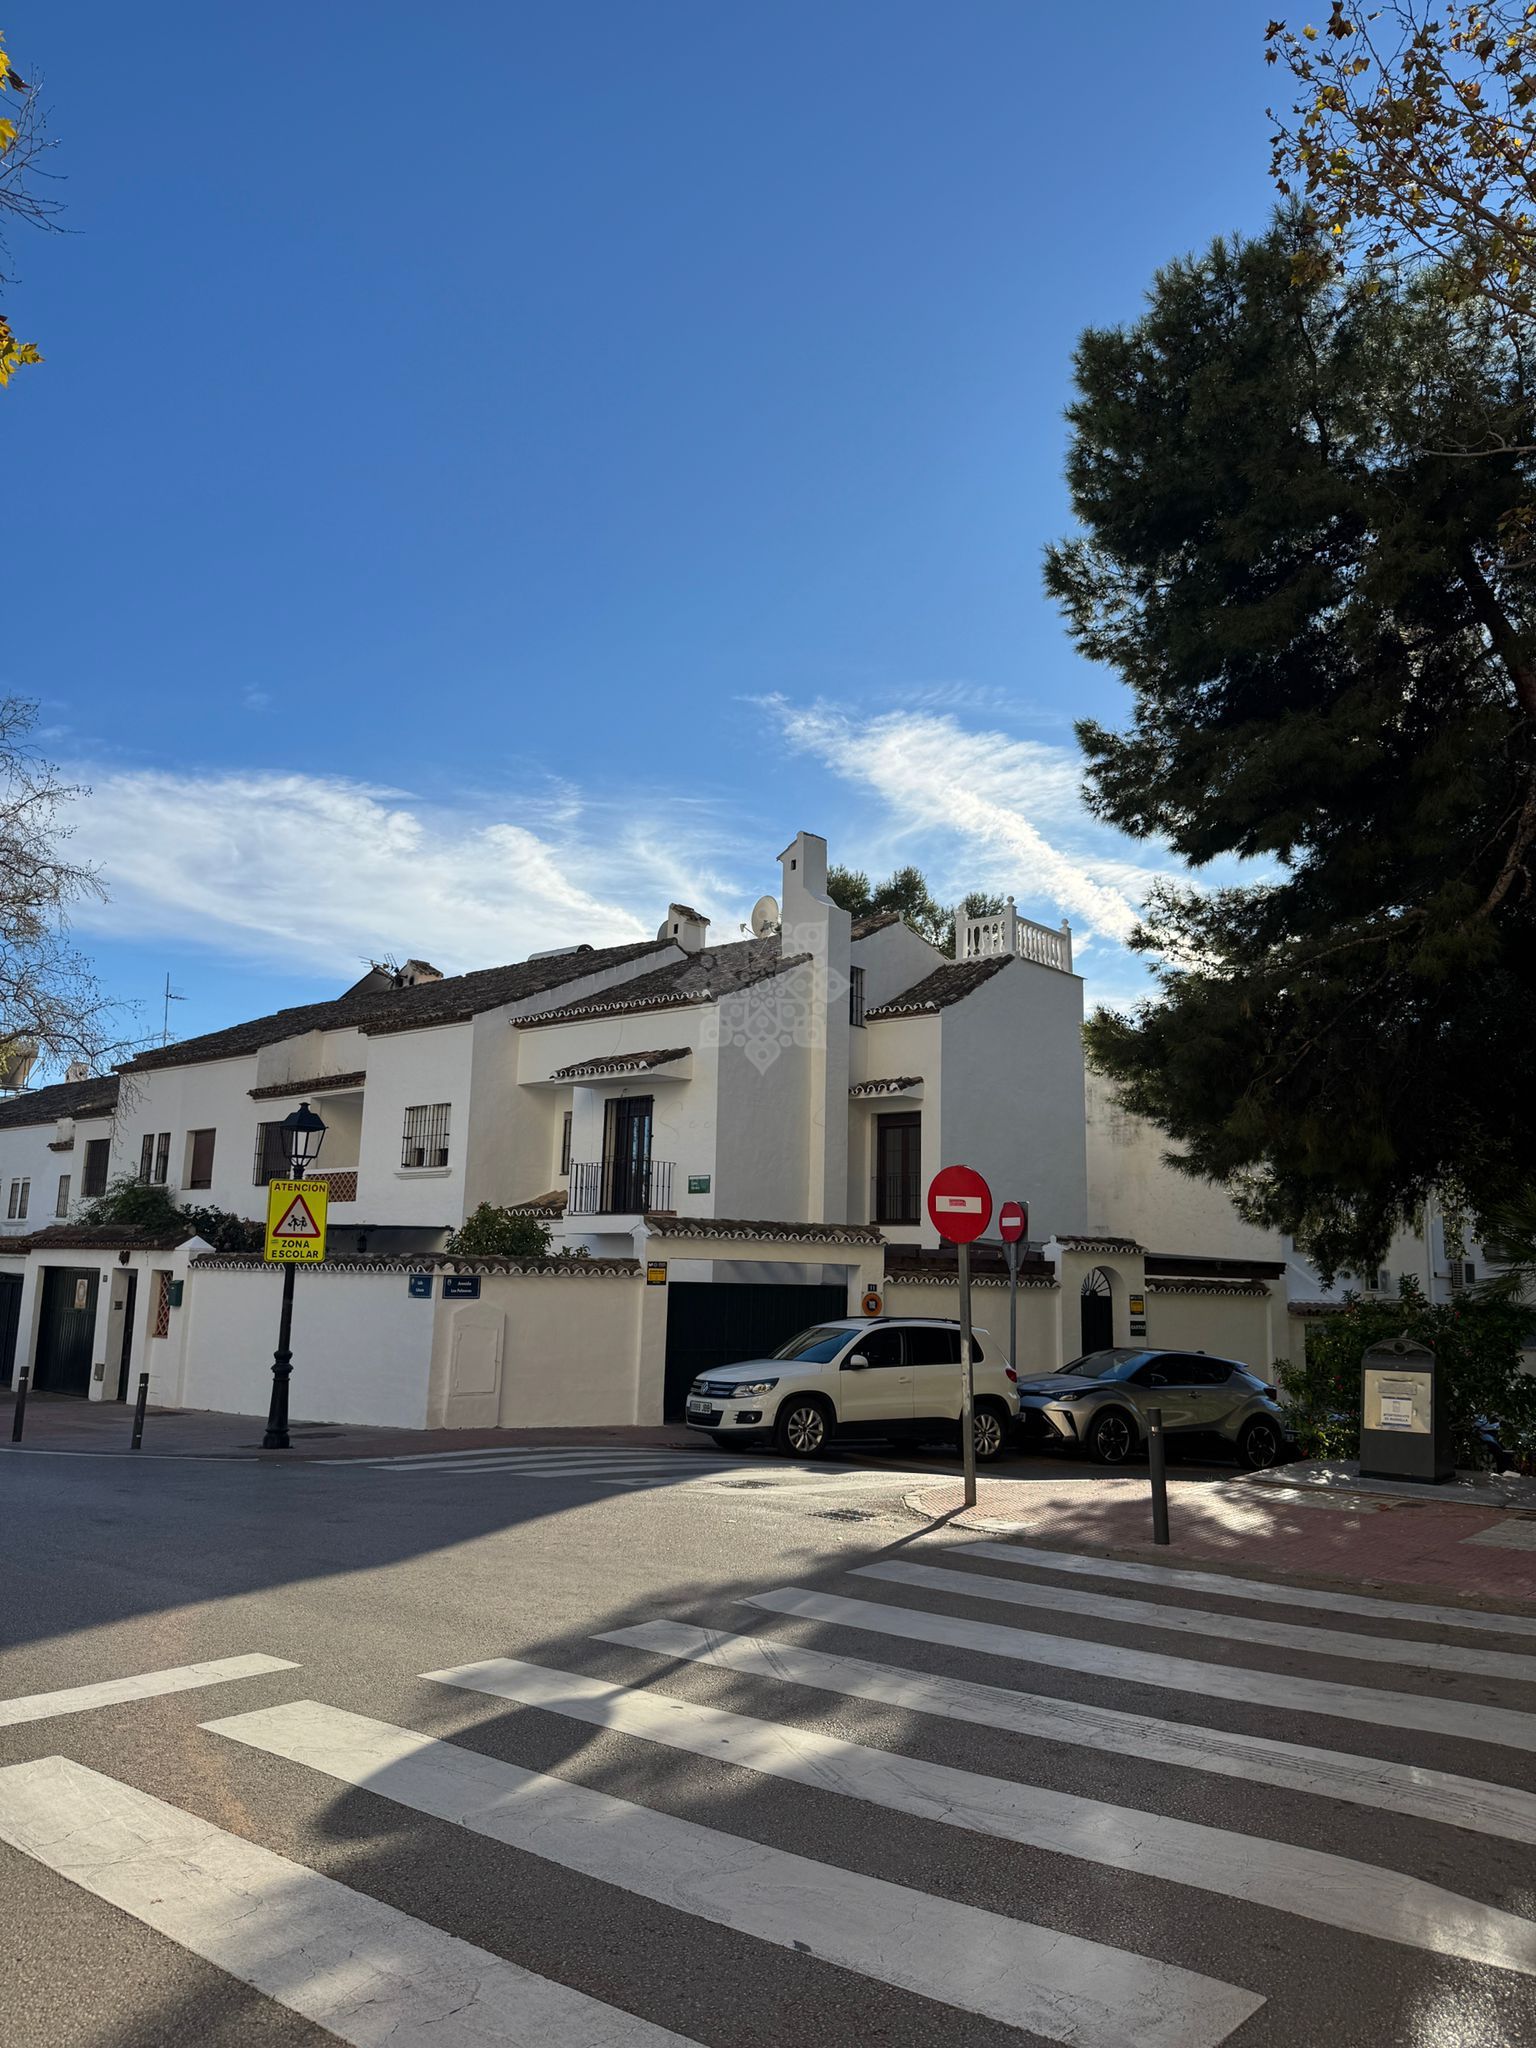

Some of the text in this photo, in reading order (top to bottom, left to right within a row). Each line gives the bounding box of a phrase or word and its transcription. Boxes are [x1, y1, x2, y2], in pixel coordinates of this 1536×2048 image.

[274, 1182, 326, 1192] ATENCIÓN
[281, 1240, 310, 1248] ZONA
[271, 1250, 319, 1258] ESCOLAR
